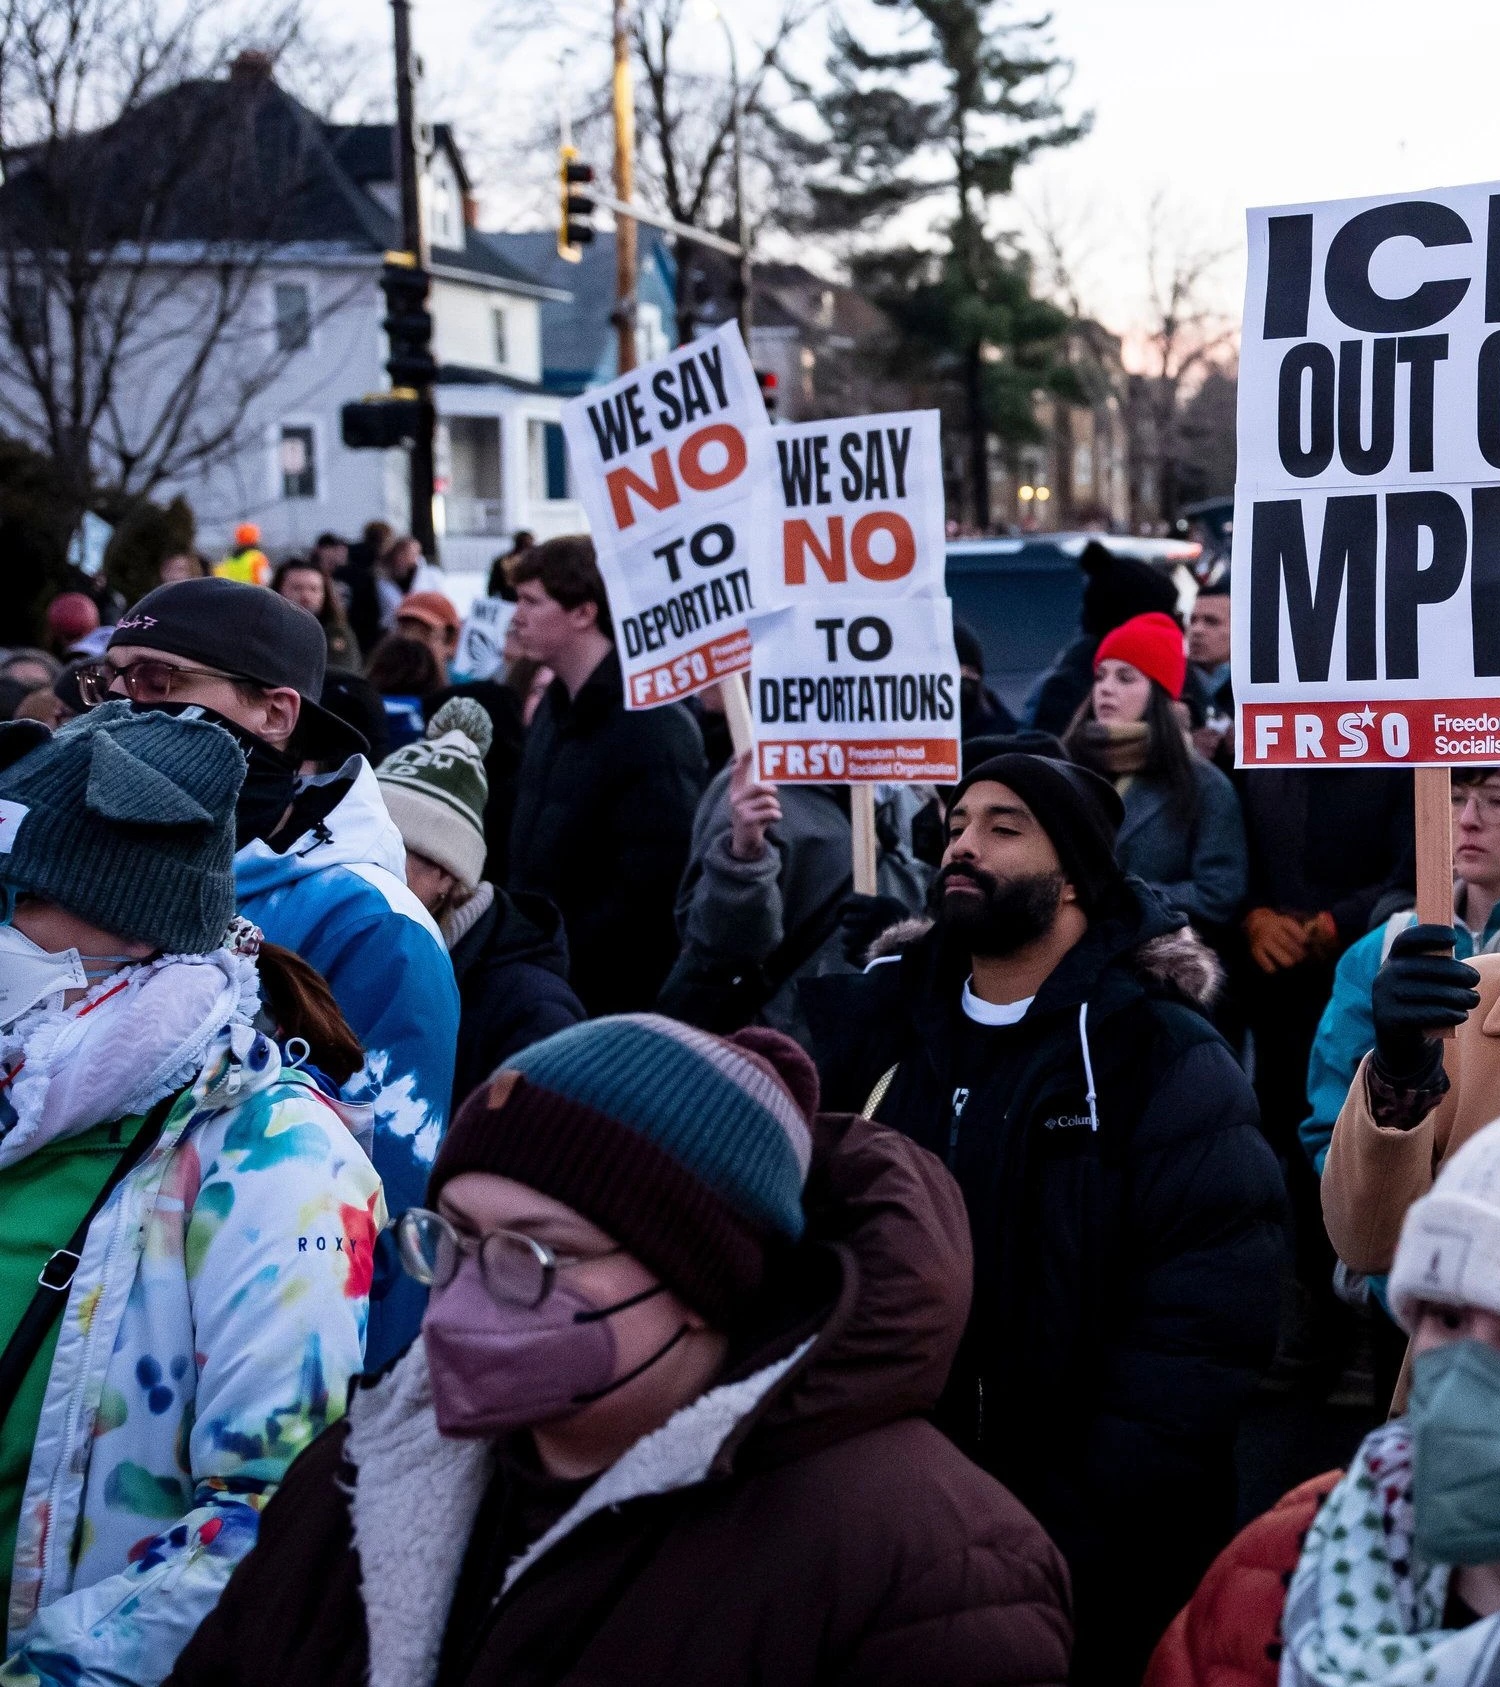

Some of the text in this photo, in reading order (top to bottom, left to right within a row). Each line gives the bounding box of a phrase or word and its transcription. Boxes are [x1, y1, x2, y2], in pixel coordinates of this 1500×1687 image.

[587, 345, 729, 462] WE SAY
[1278, 334, 1449, 478] OUT
[606, 423, 748, 531] NO
[777, 427, 912, 507] WE SAY
[654, 522, 736, 583] TO
[783, 511, 917, 585] NO
[815, 616, 893, 662] TO
[634, 651, 708, 704] FRSO
[759, 674, 954, 724] DEPORTATIONS
[763, 743, 845, 776] FRSO
[1255, 711, 1411, 759] FRSO
[298, 1236, 357, 1254] ROXY
